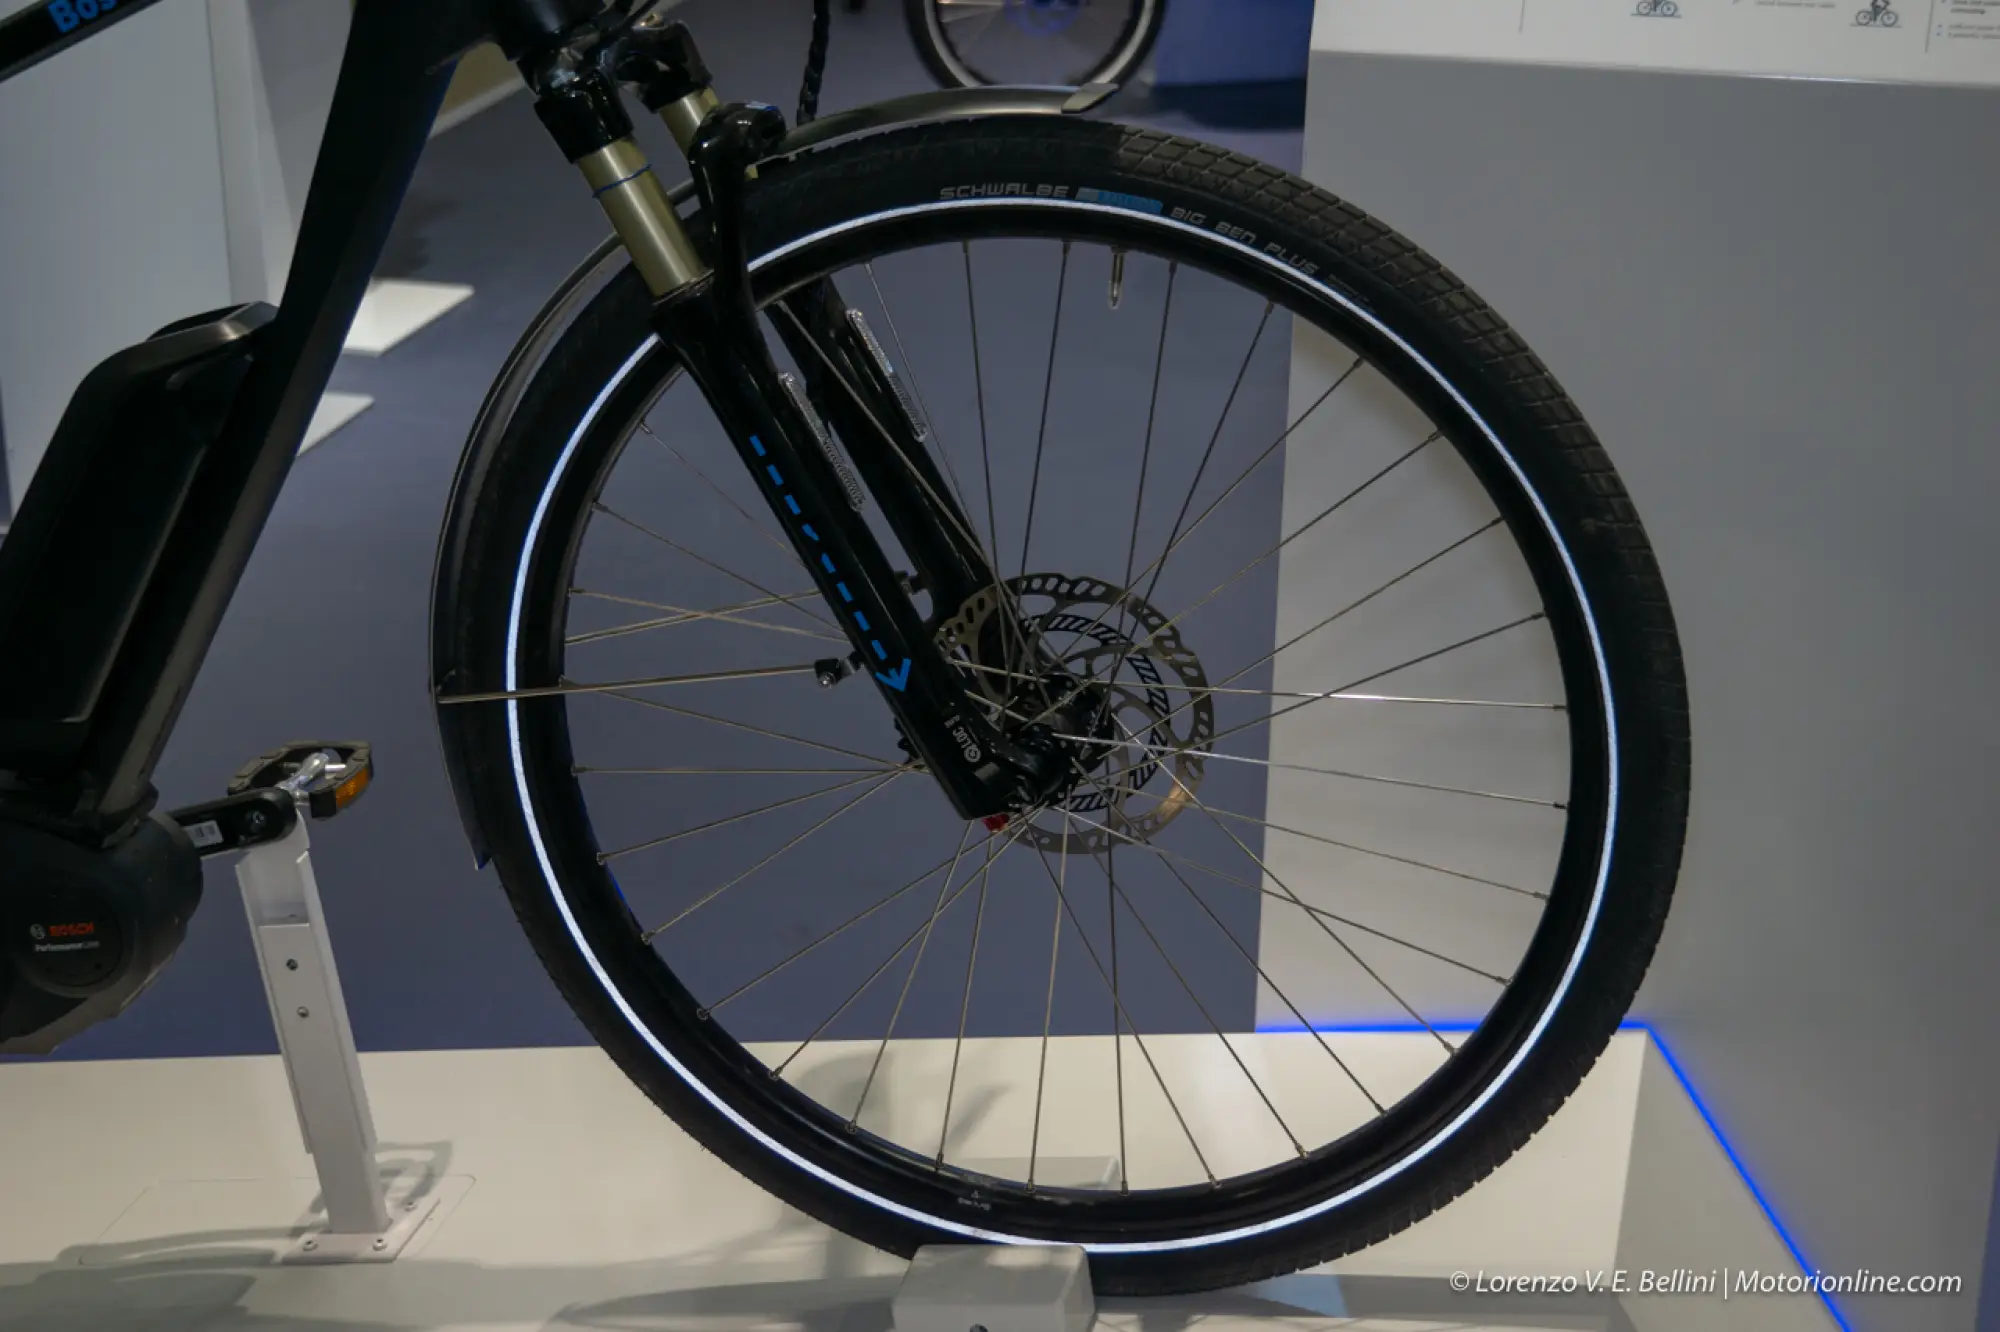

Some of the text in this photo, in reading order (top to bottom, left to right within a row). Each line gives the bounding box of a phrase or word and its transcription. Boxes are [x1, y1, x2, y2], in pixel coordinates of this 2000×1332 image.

[940, 182, 1070, 200] SCHWALBE
[1170, 206, 1320, 276] BIG BEN PLUS
